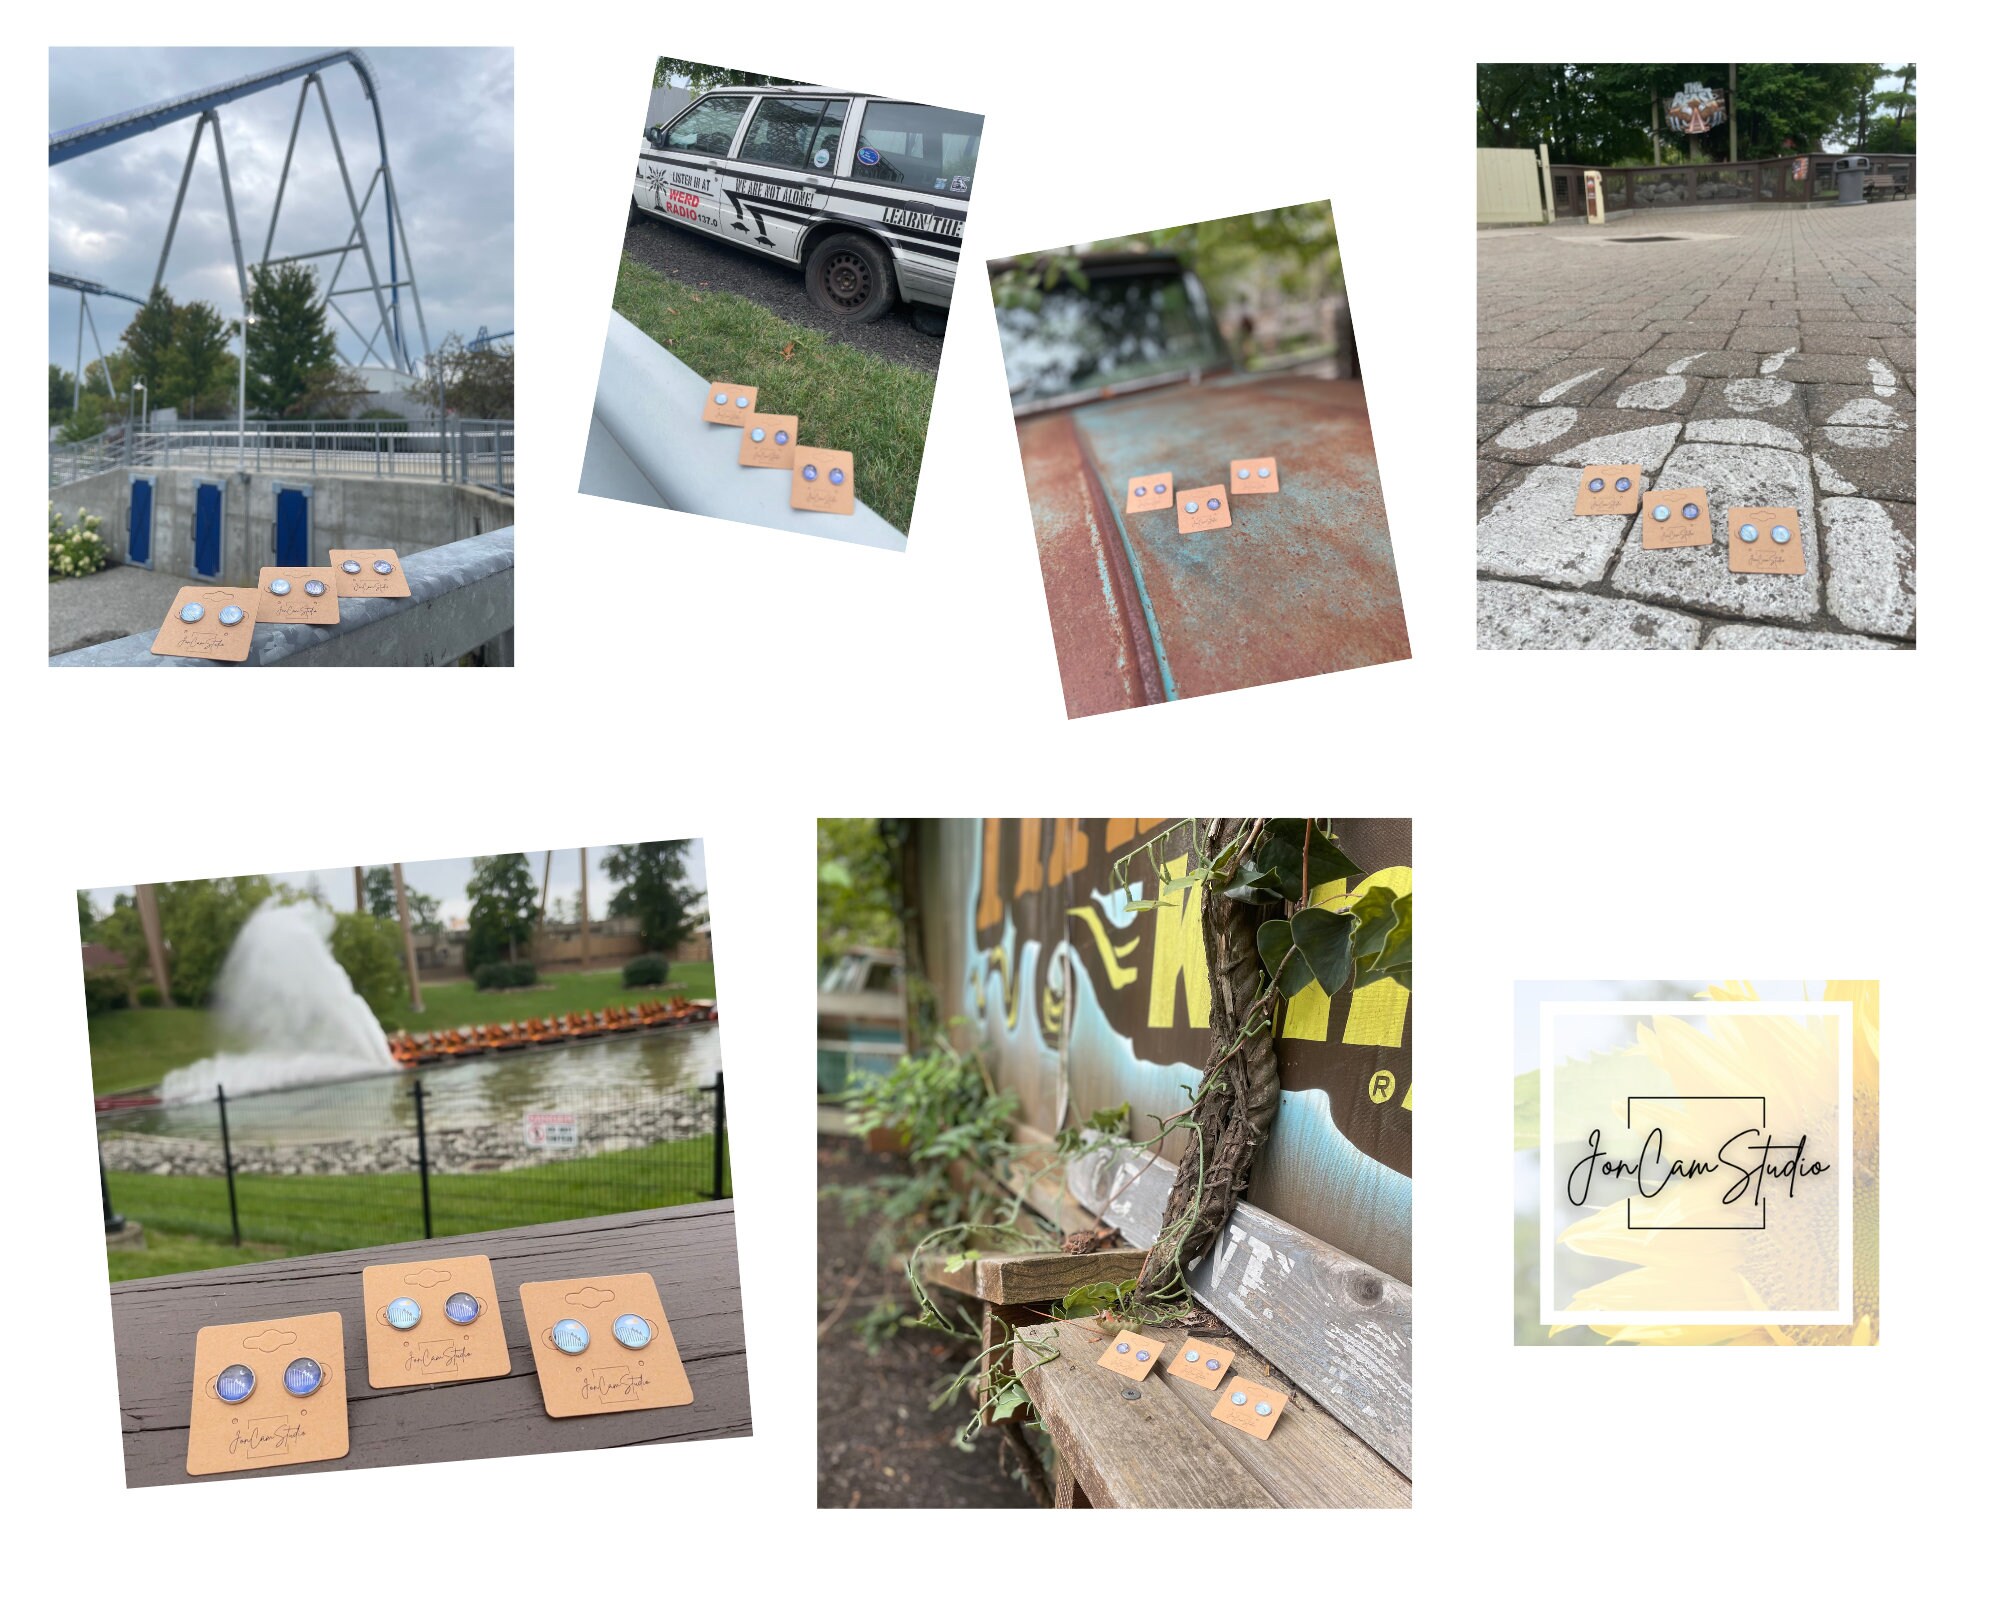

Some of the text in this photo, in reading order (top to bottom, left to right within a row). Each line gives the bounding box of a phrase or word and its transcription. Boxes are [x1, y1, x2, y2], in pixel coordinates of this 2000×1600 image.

[672, 171, 711, 191] LISTEN IN AT
[669, 188, 700, 208] WERD
[735, 178, 815, 208] WE ARE NOT ALONE!
[666, 201, 697, 221] RADIO
[698, 214, 718, 228] 137.0
[882, 207, 964, 237] LEARN THE
